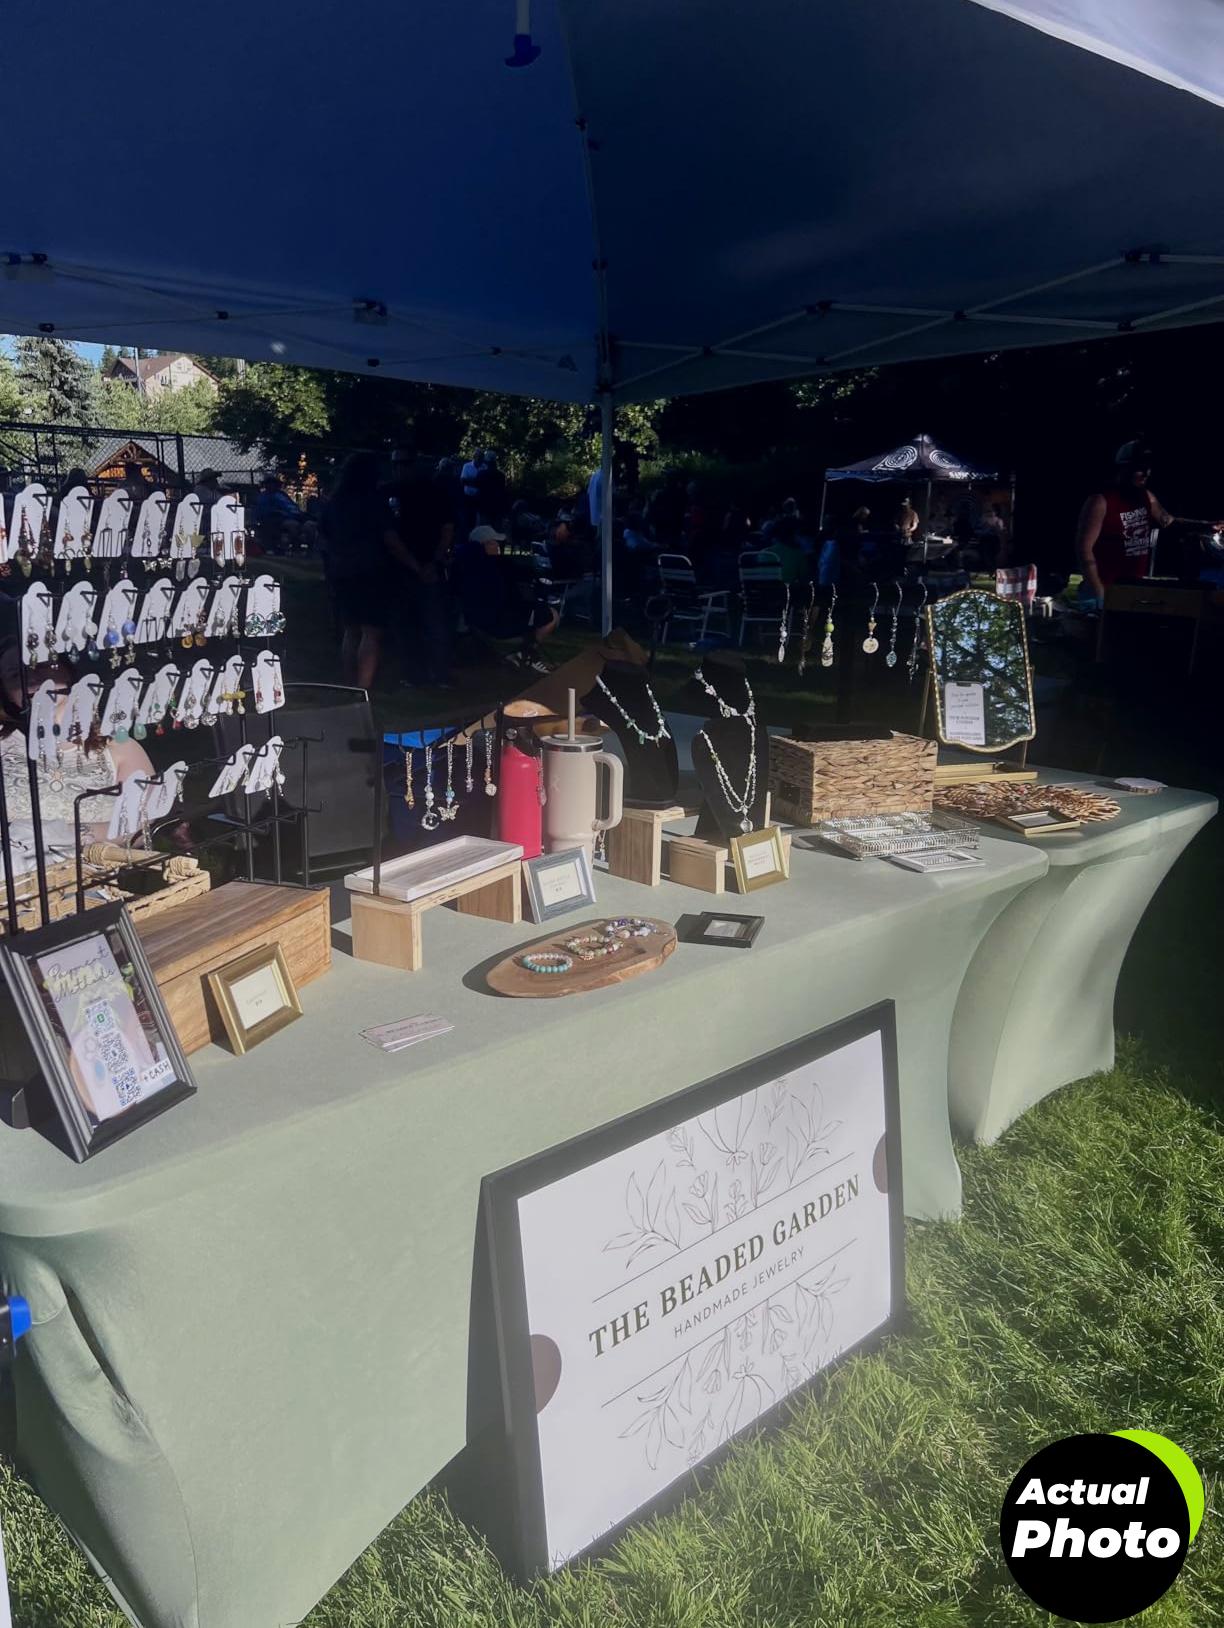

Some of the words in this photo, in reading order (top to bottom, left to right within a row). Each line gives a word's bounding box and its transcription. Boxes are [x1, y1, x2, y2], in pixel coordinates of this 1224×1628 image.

[48, 945, 109, 983] Payment
[55, 969, 115, 1003] Methods
[149, 1061, 171, 1079] CASH
[588, 1301, 650, 1358] THE
[659, 1234, 764, 1318] BEADED
[772, 1174, 860, 1247] GARDEN
[673, 1282, 749, 1338] HANDMADE
[752, 1246, 805, 1290] JEWELRY
